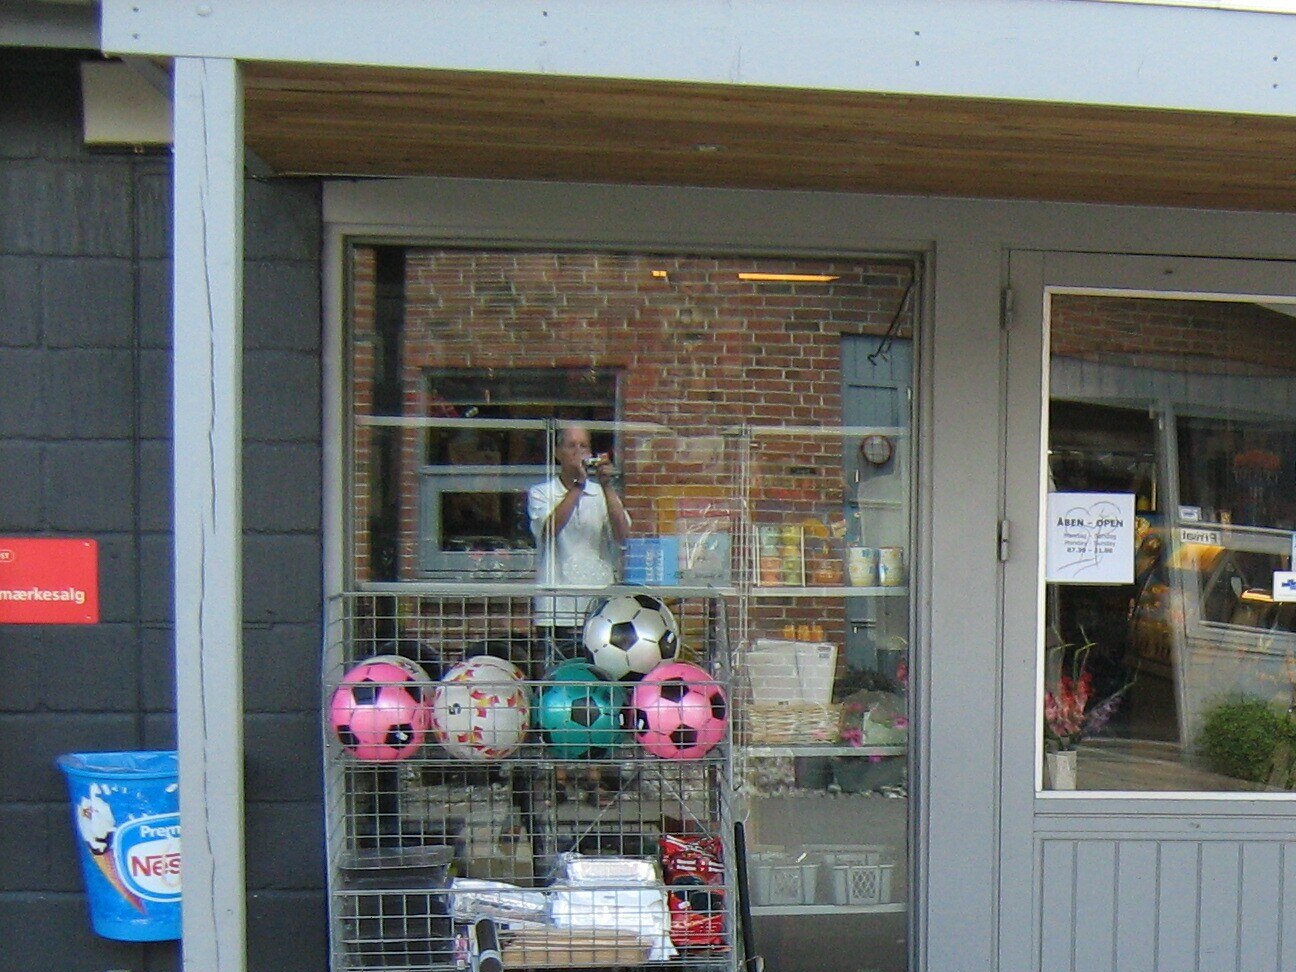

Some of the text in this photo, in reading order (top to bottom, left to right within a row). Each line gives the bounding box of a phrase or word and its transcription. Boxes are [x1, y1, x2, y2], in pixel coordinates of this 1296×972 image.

[1057, 516, 1085, 527] ÅBEN
[1096, 518, 1124, 528] OPEN
[0, 586, 86, 605] mærkesalg
[140, 824, 181, 838] Prem
[131, 853, 181, 877] Nes
